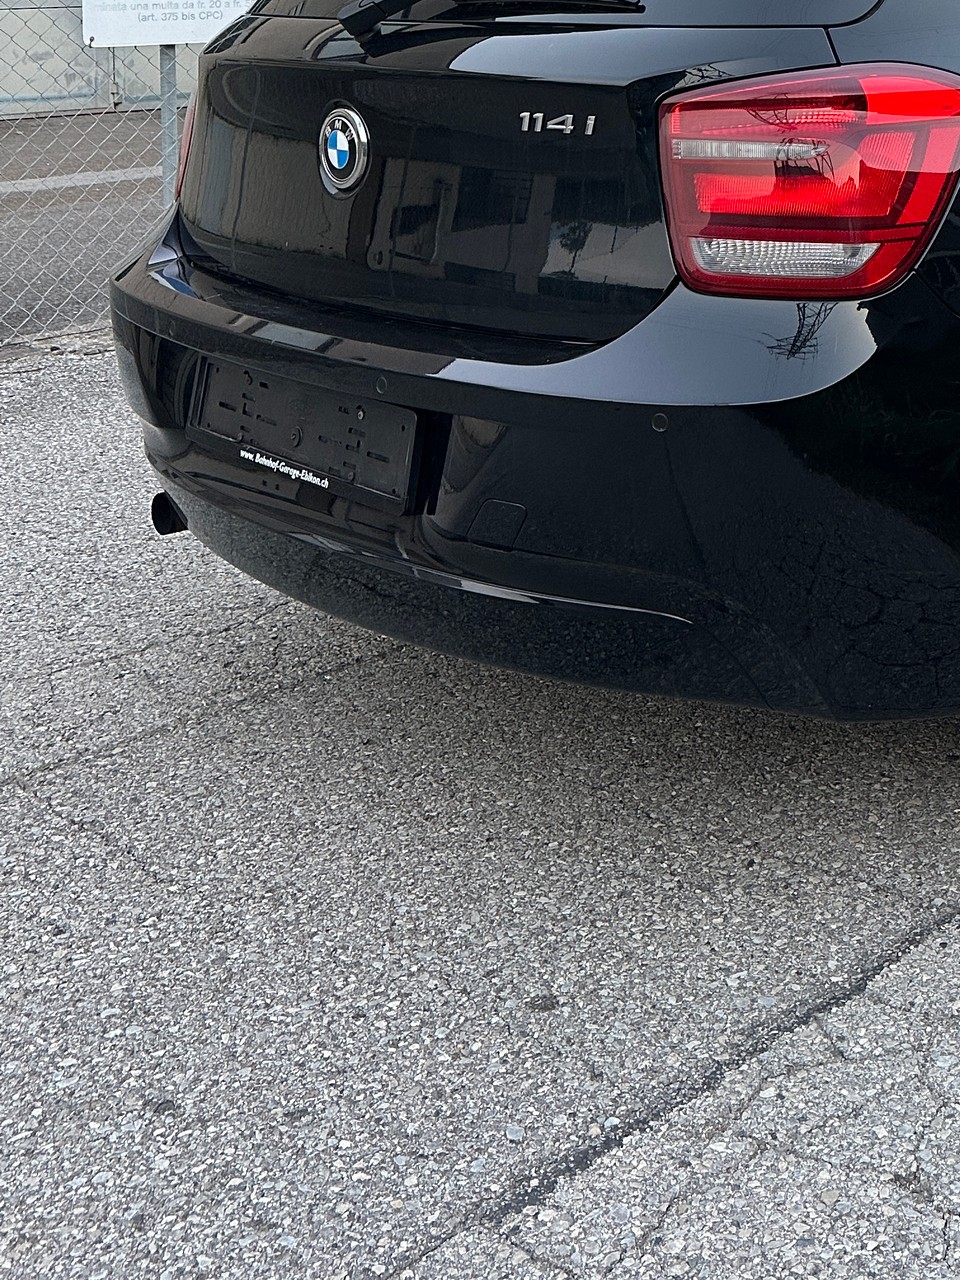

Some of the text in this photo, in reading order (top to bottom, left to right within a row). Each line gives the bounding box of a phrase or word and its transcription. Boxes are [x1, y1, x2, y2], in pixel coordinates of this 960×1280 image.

[130, 3, 149, 11] una
[152, 1, 179, 10] multa
[182, 0, 194, 10] da
[209, 0, 222, 9] 20
[137, 10, 224, 23] (art. 375 bis CPC)
[325, 119, 355, 141] BMW
